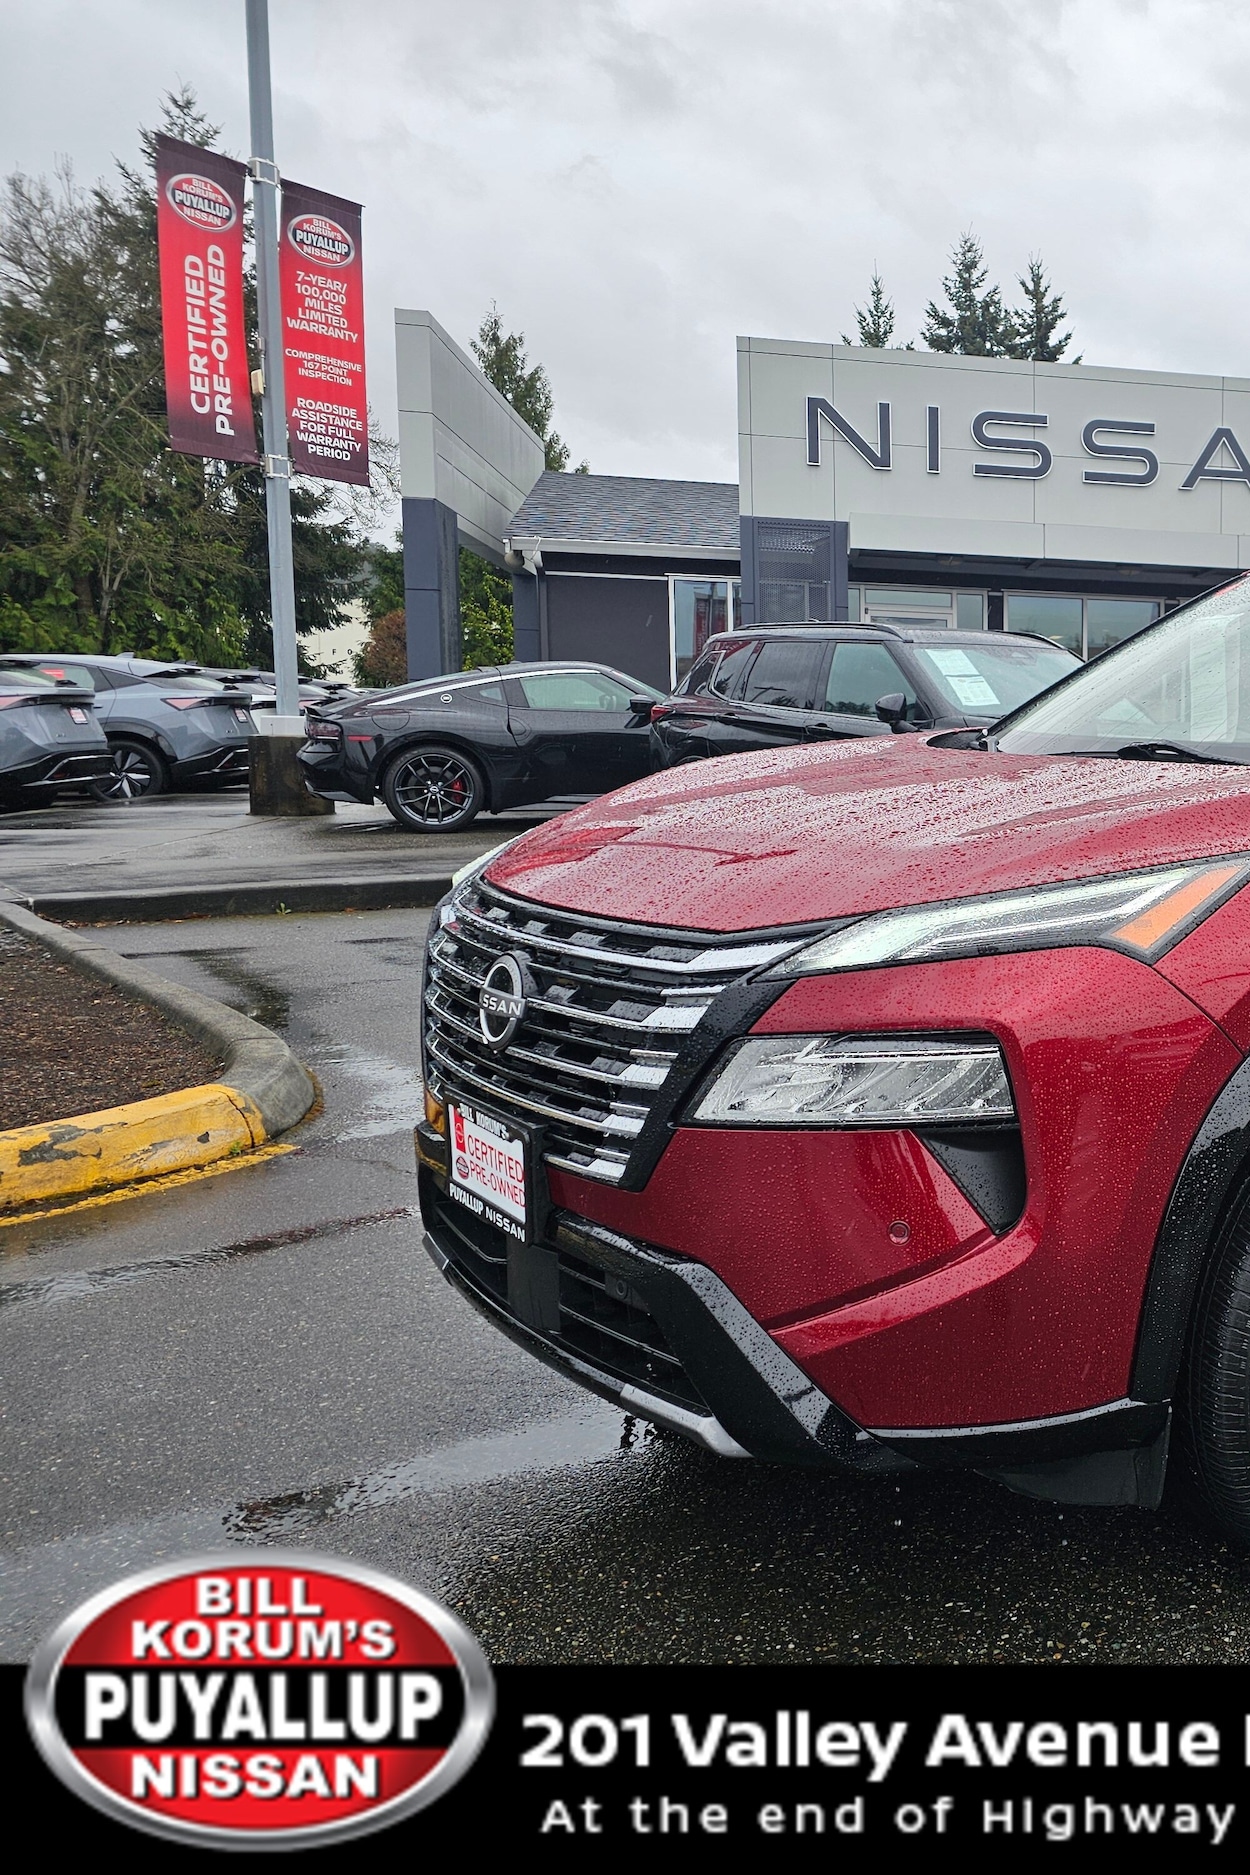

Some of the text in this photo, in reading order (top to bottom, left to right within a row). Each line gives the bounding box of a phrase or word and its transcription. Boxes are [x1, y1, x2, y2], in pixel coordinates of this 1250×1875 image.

[182, 183, 223, 202] KORUM'S
[192, 178, 213, 191] BILL
[174, 189, 230, 218] PUYALLUP
[183, 206, 221, 226] NISSAN
[313, 219, 331, 230] BILL
[296, 229, 349, 255] PUYALLUP
[303, 223, 342, 240] KORUM'S
[303, 245, 340, 262] NISSAN
[296, 271, 347, 293] 7-YEAR/
[295, 283, 347, 305] 100,000
[298, 307, 348, 328] LIMITED
[304, 298, 342, 316] MILES
[184, 254, 211, 414] CERTIFIED
[207, 244, 235, 436] PRE-OWNED
[287, 317, 358, 343] WARRANTY
[285, 348, 362, 372] COMPREHENSIVE
[303, 360, 348, 376] 167 POINT
[298, 367, 352, 386] INSPECTION
[292, 407, 363, 431] ASSISTANCE
[296, 397, 357, 419] ROADSIDE
[296, 430, 361, 452] WARRANTY
[300, 420, 355, 440] FOR FULL
[307, 444, 351, 461] PERIOD
[482, 993, 521, 1015] SSAN
[459, 1102, 475, 1122] BILL
[467, 1134, 524, 1184] CERTIFIED
[469, 1160, 526, 1208] PRE-OWNED
[449, 1182, 526, 1243] PUYALLUP NISSAN
